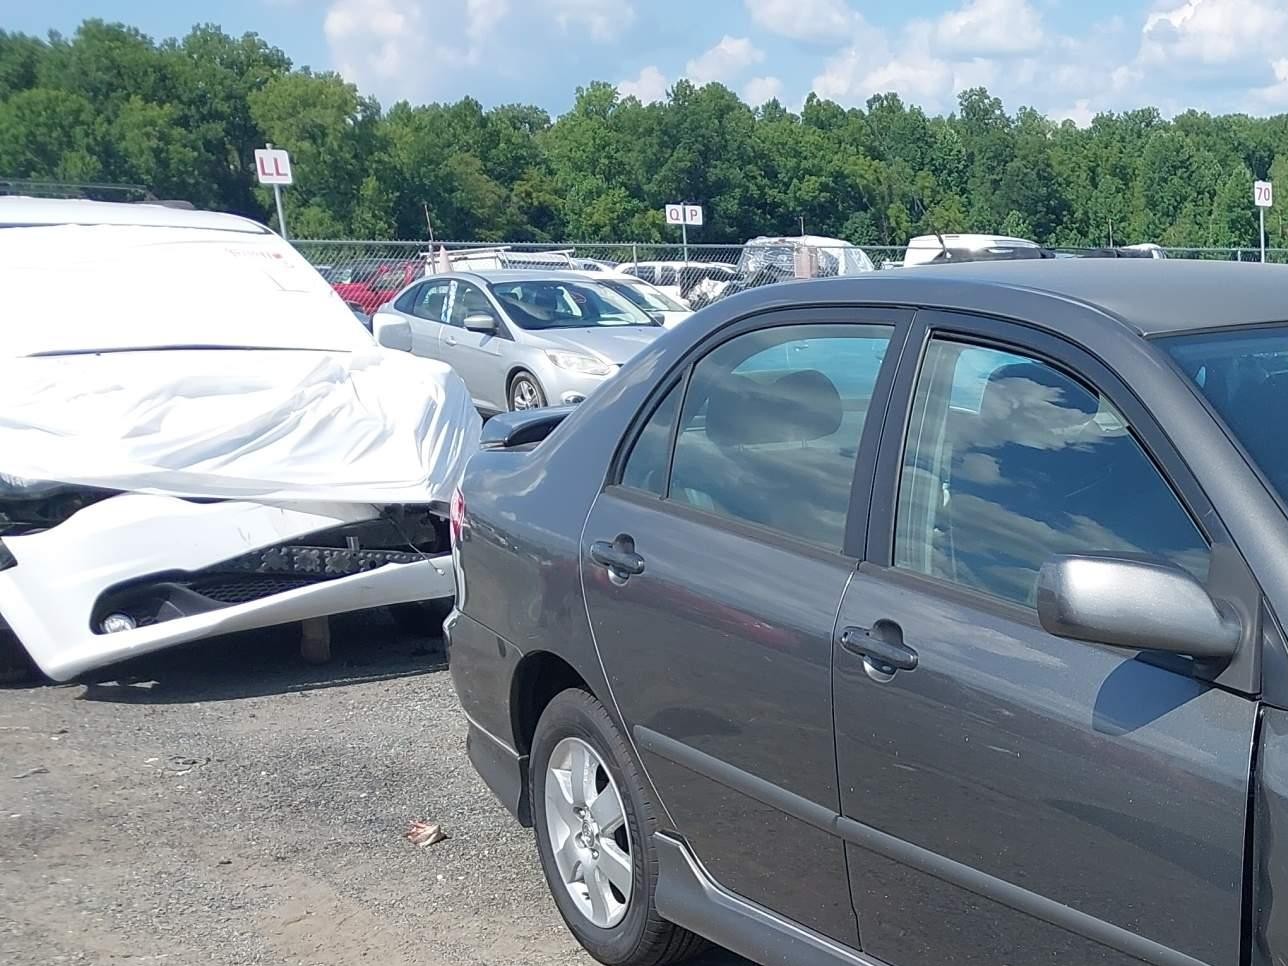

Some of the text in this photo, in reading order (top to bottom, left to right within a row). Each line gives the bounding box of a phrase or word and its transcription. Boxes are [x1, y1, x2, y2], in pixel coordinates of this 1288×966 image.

[259, 156, 288, 176] LL
[1256, 187, 1270, 201] 70
[669, 208, 698, 221] Q P
